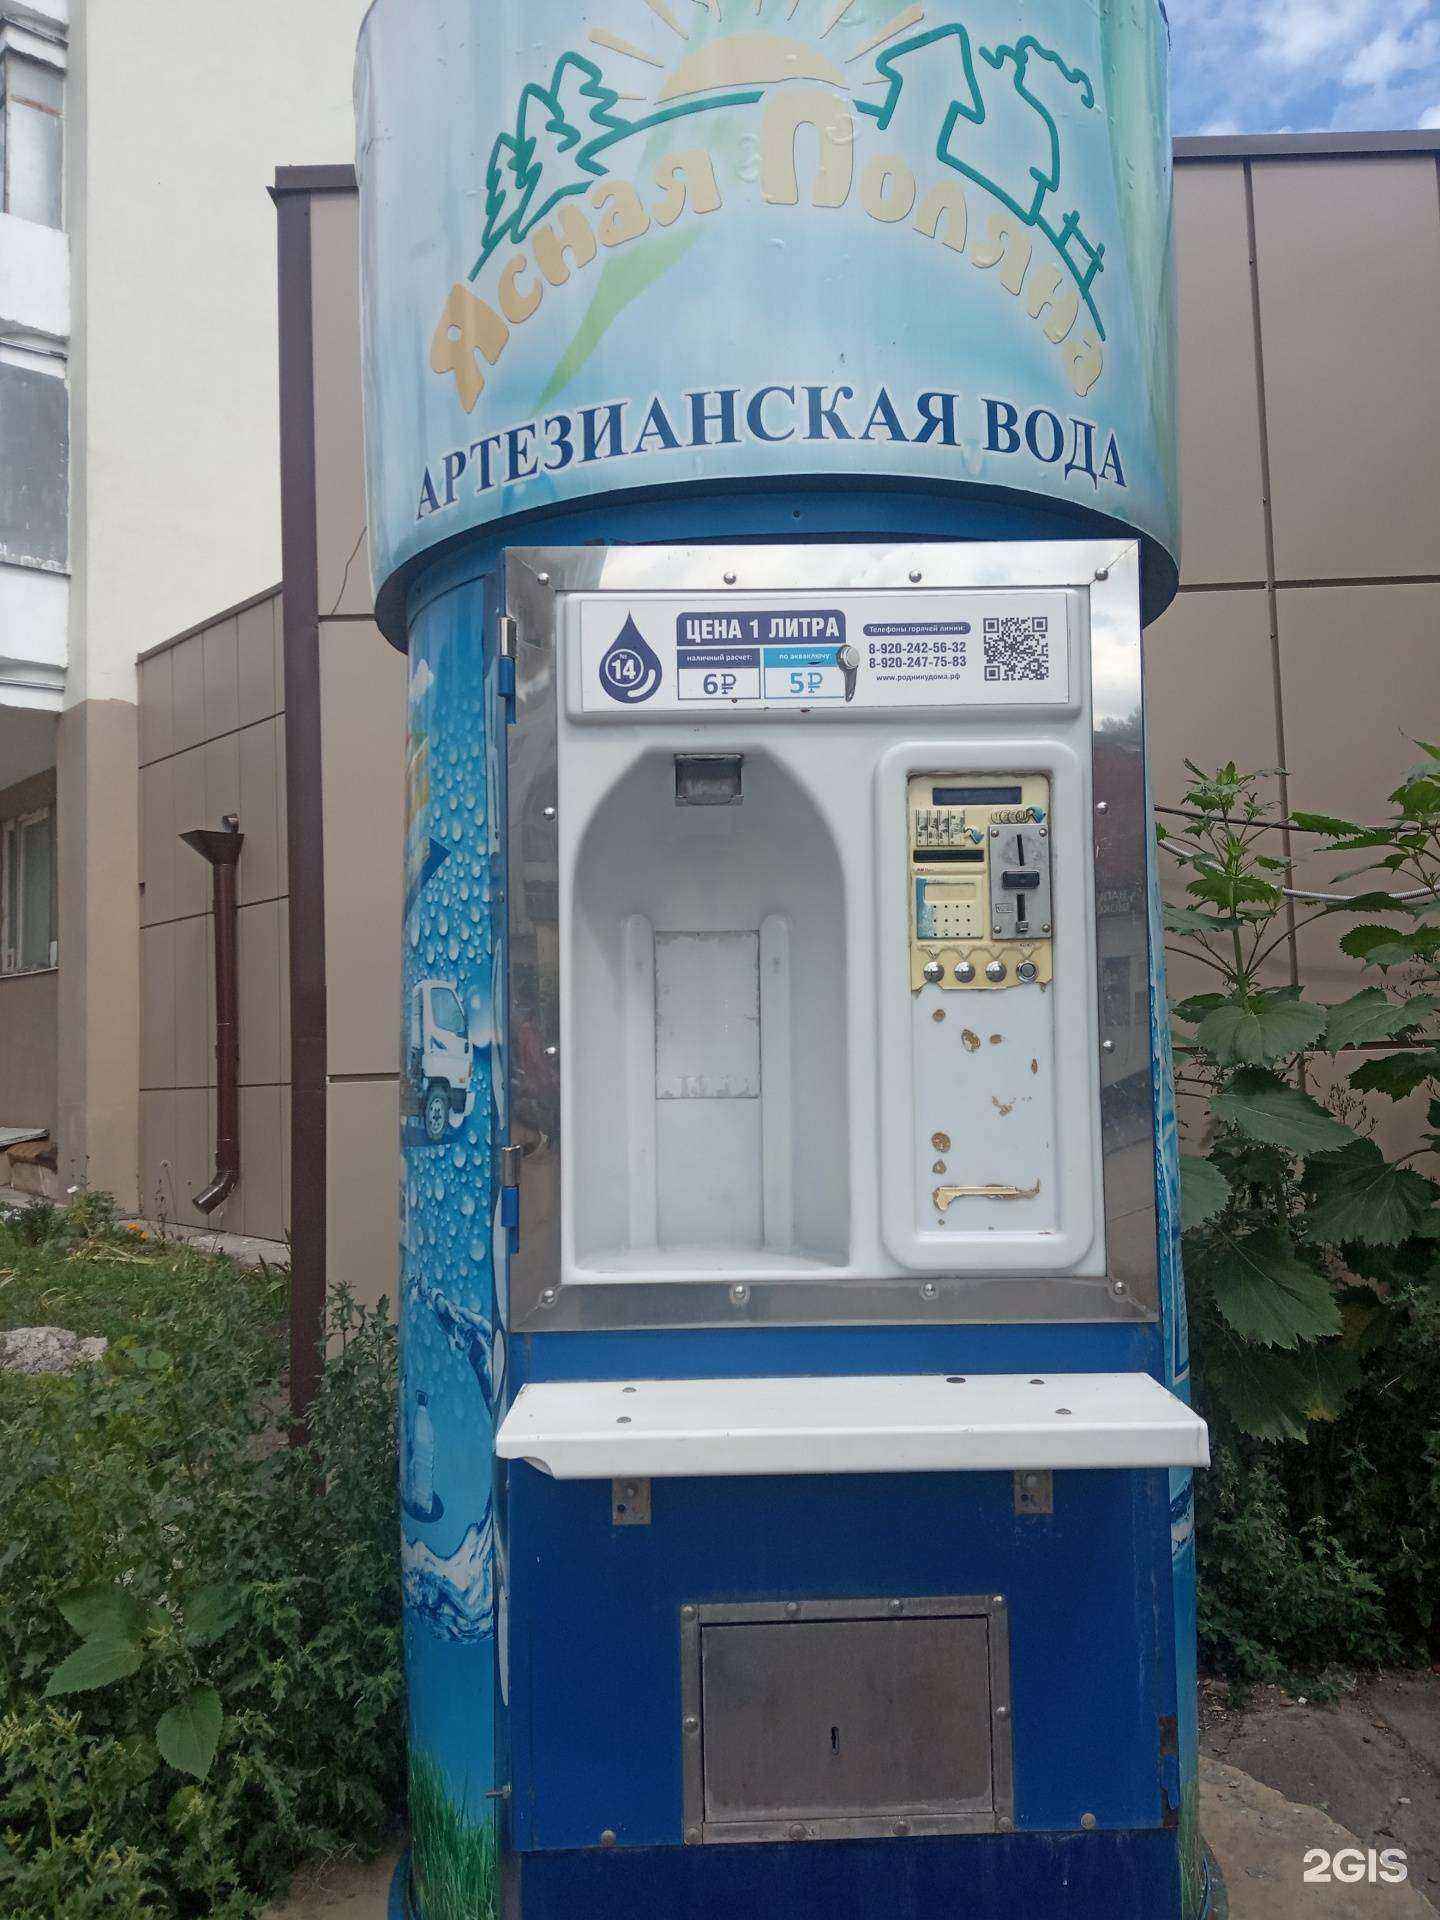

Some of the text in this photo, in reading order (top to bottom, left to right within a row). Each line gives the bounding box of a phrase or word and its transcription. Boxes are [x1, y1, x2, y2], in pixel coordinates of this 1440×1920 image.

[430, 87, 1104, 413] Ясная Поляна
[416, 385, 1128, 519] АРТЕЗИАНСКАЯ ВОДА
[686, 617, 840, 643] ЦЕНА 1 ЛИТРА
[686, 654, 725, 662] наличный
[868, 642, 967, 654] 8-920-242-56-32
[611, 659, 636, 680] 14
[868, 656, 967, 668] 8-920-247-75-83
